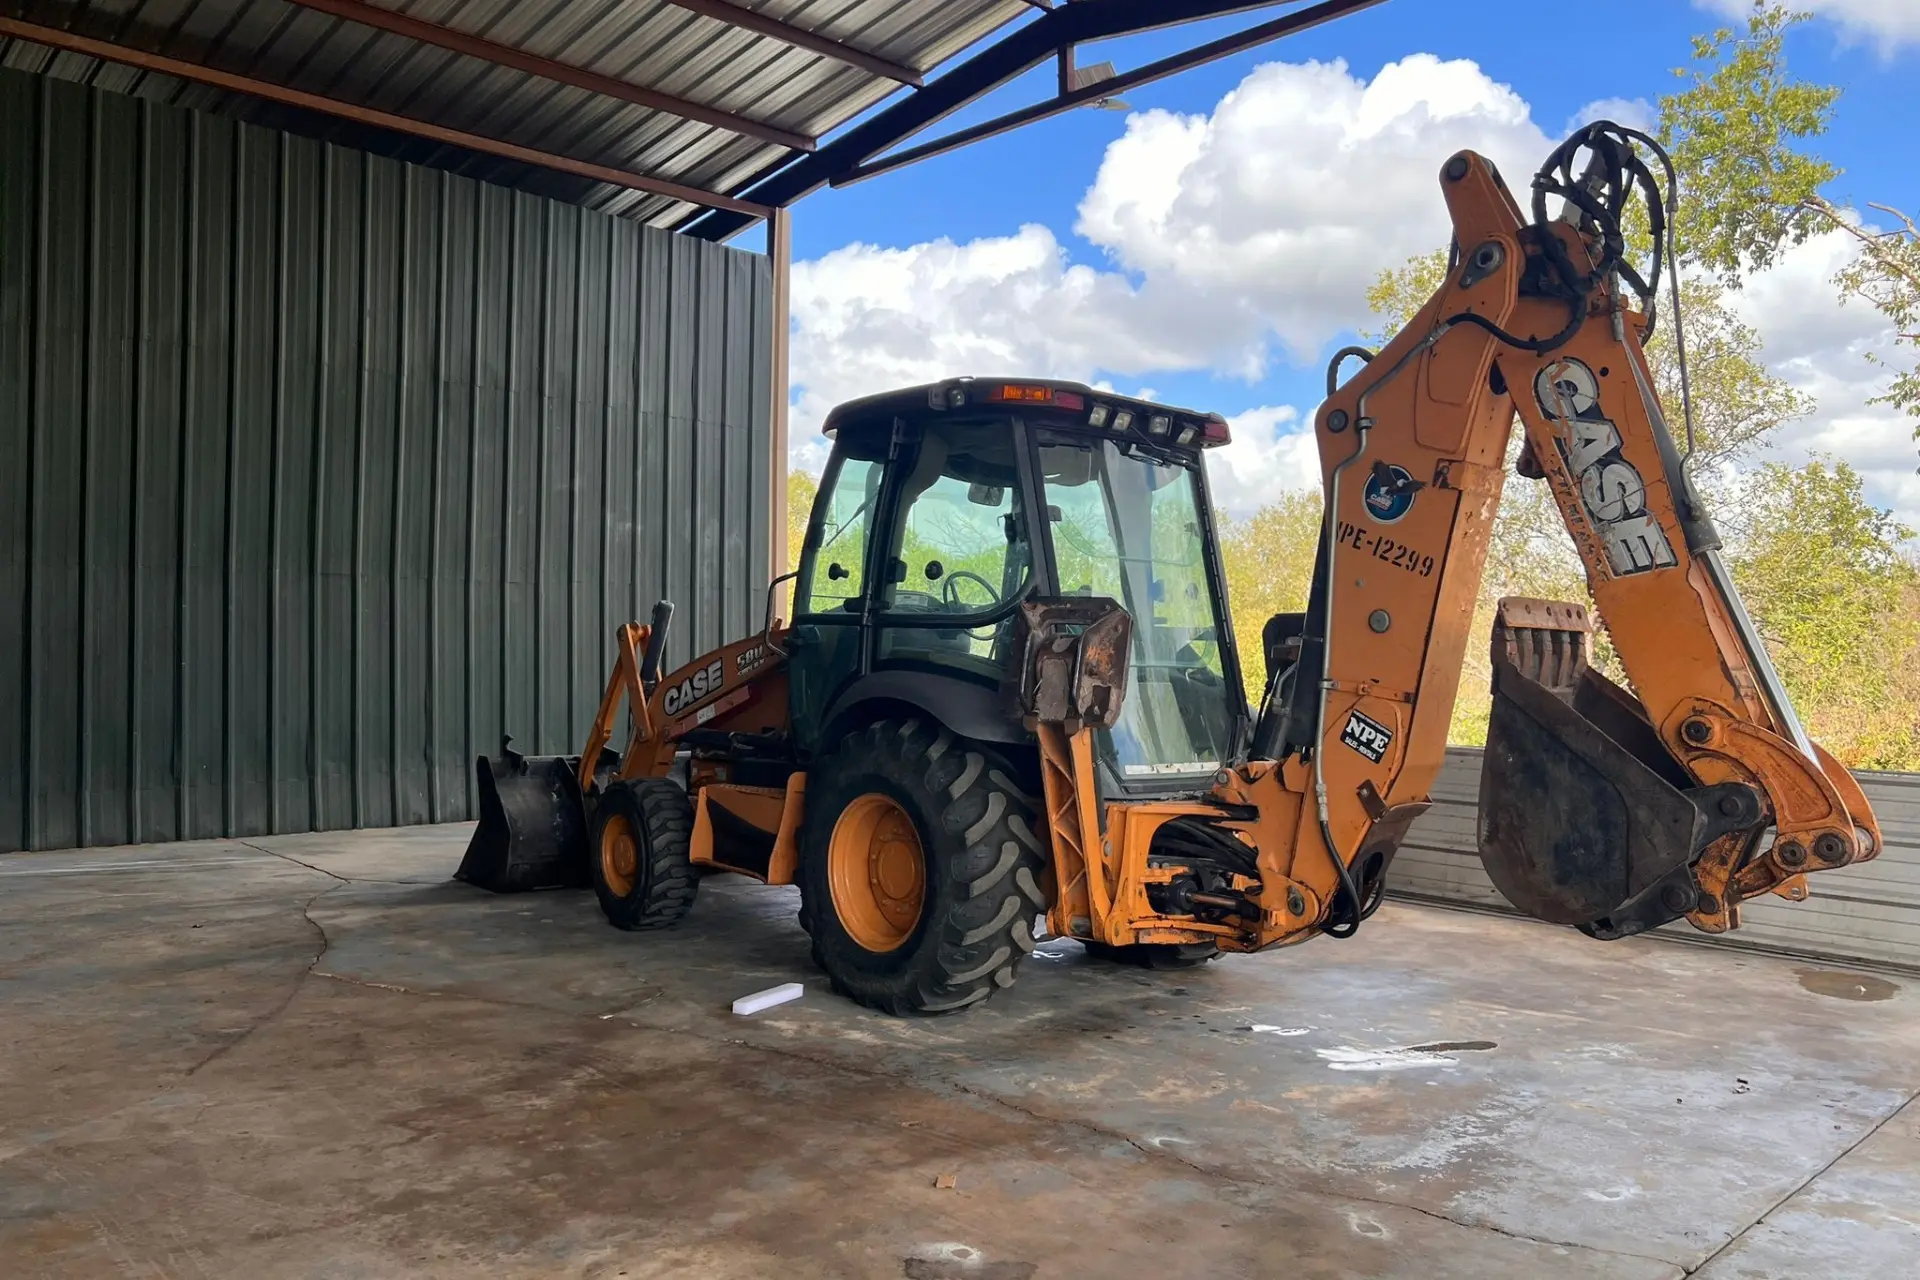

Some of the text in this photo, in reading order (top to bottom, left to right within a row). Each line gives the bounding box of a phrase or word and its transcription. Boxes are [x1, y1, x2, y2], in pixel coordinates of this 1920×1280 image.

[1533, 356, 1679, 578] CASE
[664, 658, 723, 715] CASE
[1346, 717, 1388, 753] NPE
